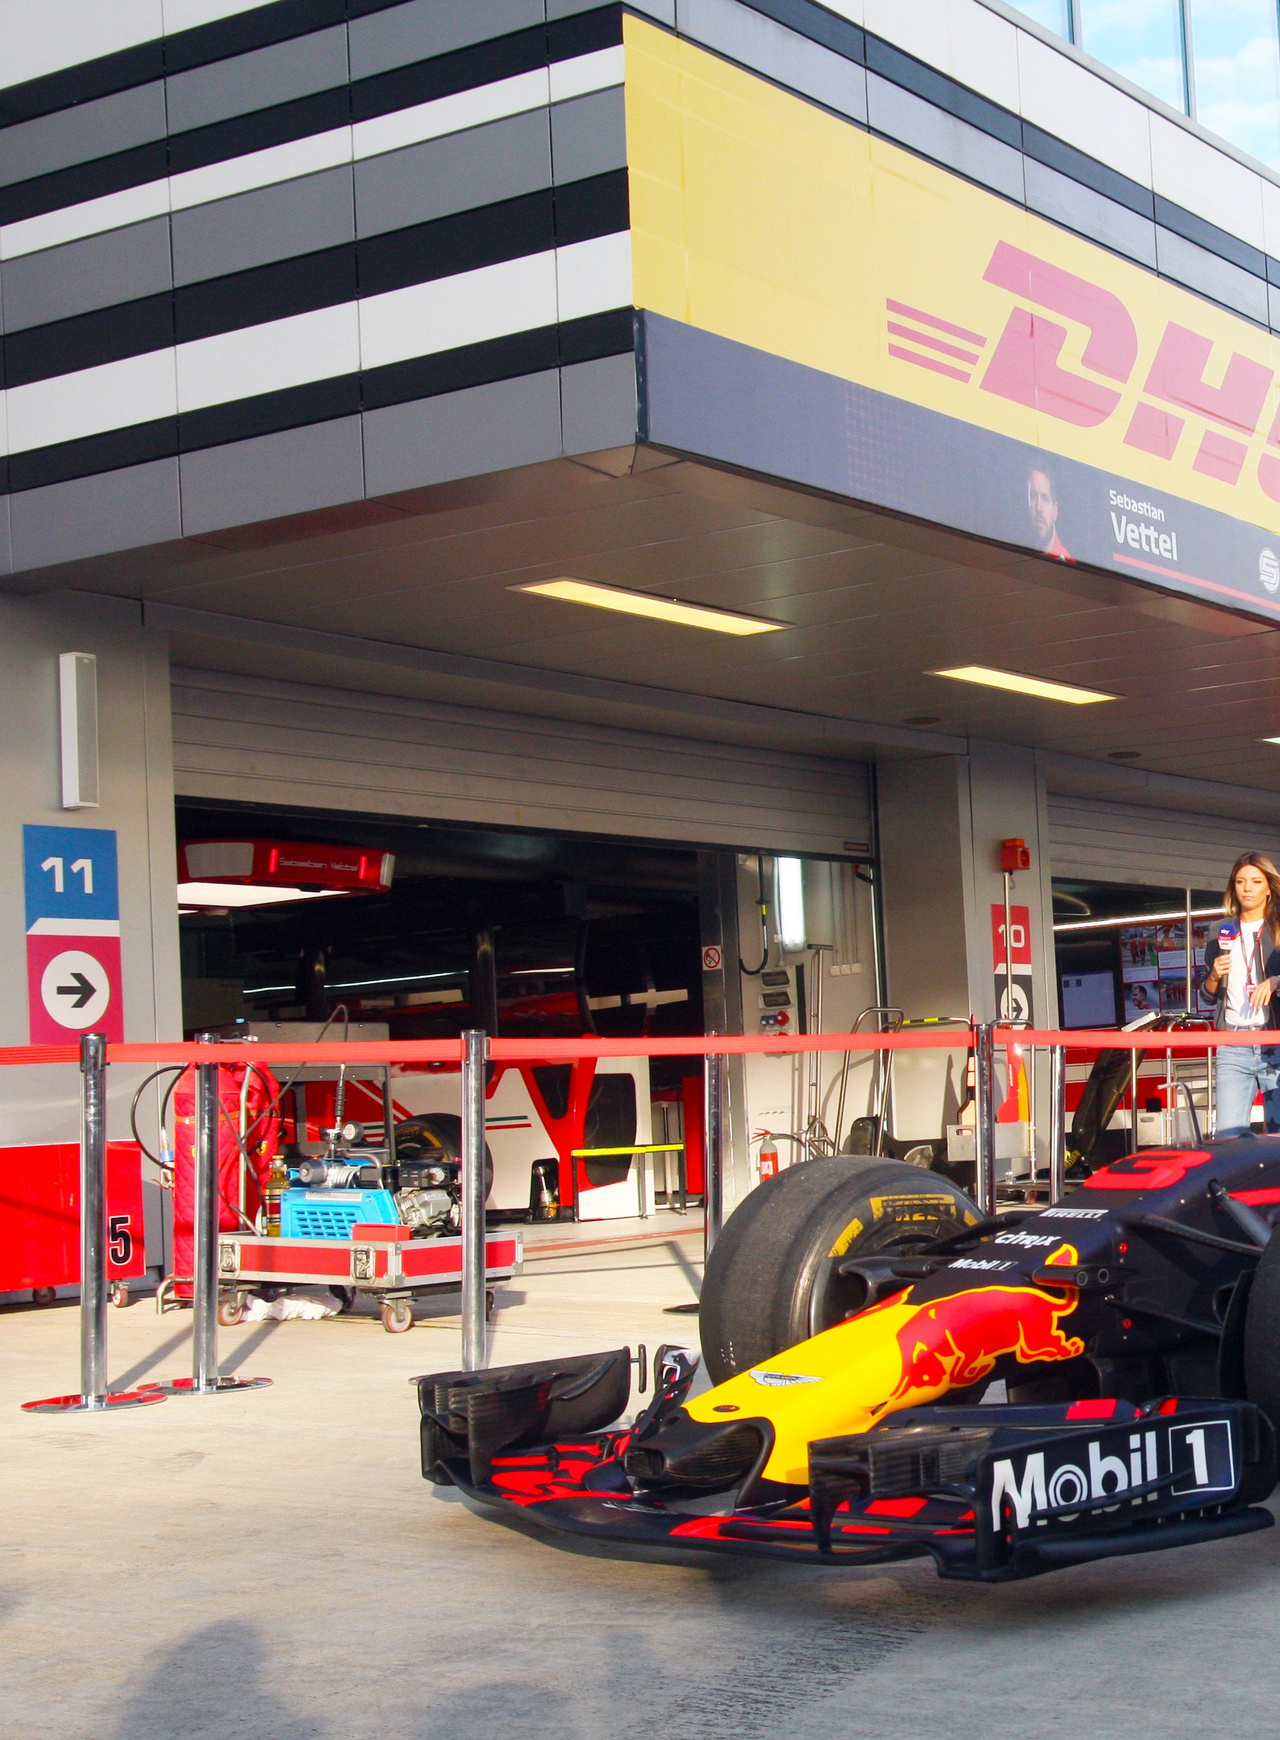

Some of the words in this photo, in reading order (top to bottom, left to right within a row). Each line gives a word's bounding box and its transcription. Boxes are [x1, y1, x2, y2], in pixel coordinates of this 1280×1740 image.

[1109, 489, 1165, 522] Sebastian
[1110, 511, 1178, 561] Vettel
[40, 857, 95, 894] 11
[1083, 1150, 1212, 1189] 3
[1039, 1208, 1109, 1219] PIRELLI
[948, 1259, 1000, 1270] Mobil
[991, 1431, 1158, 1533] Mobil
[1185, 1428, 1209, 1485] 1
